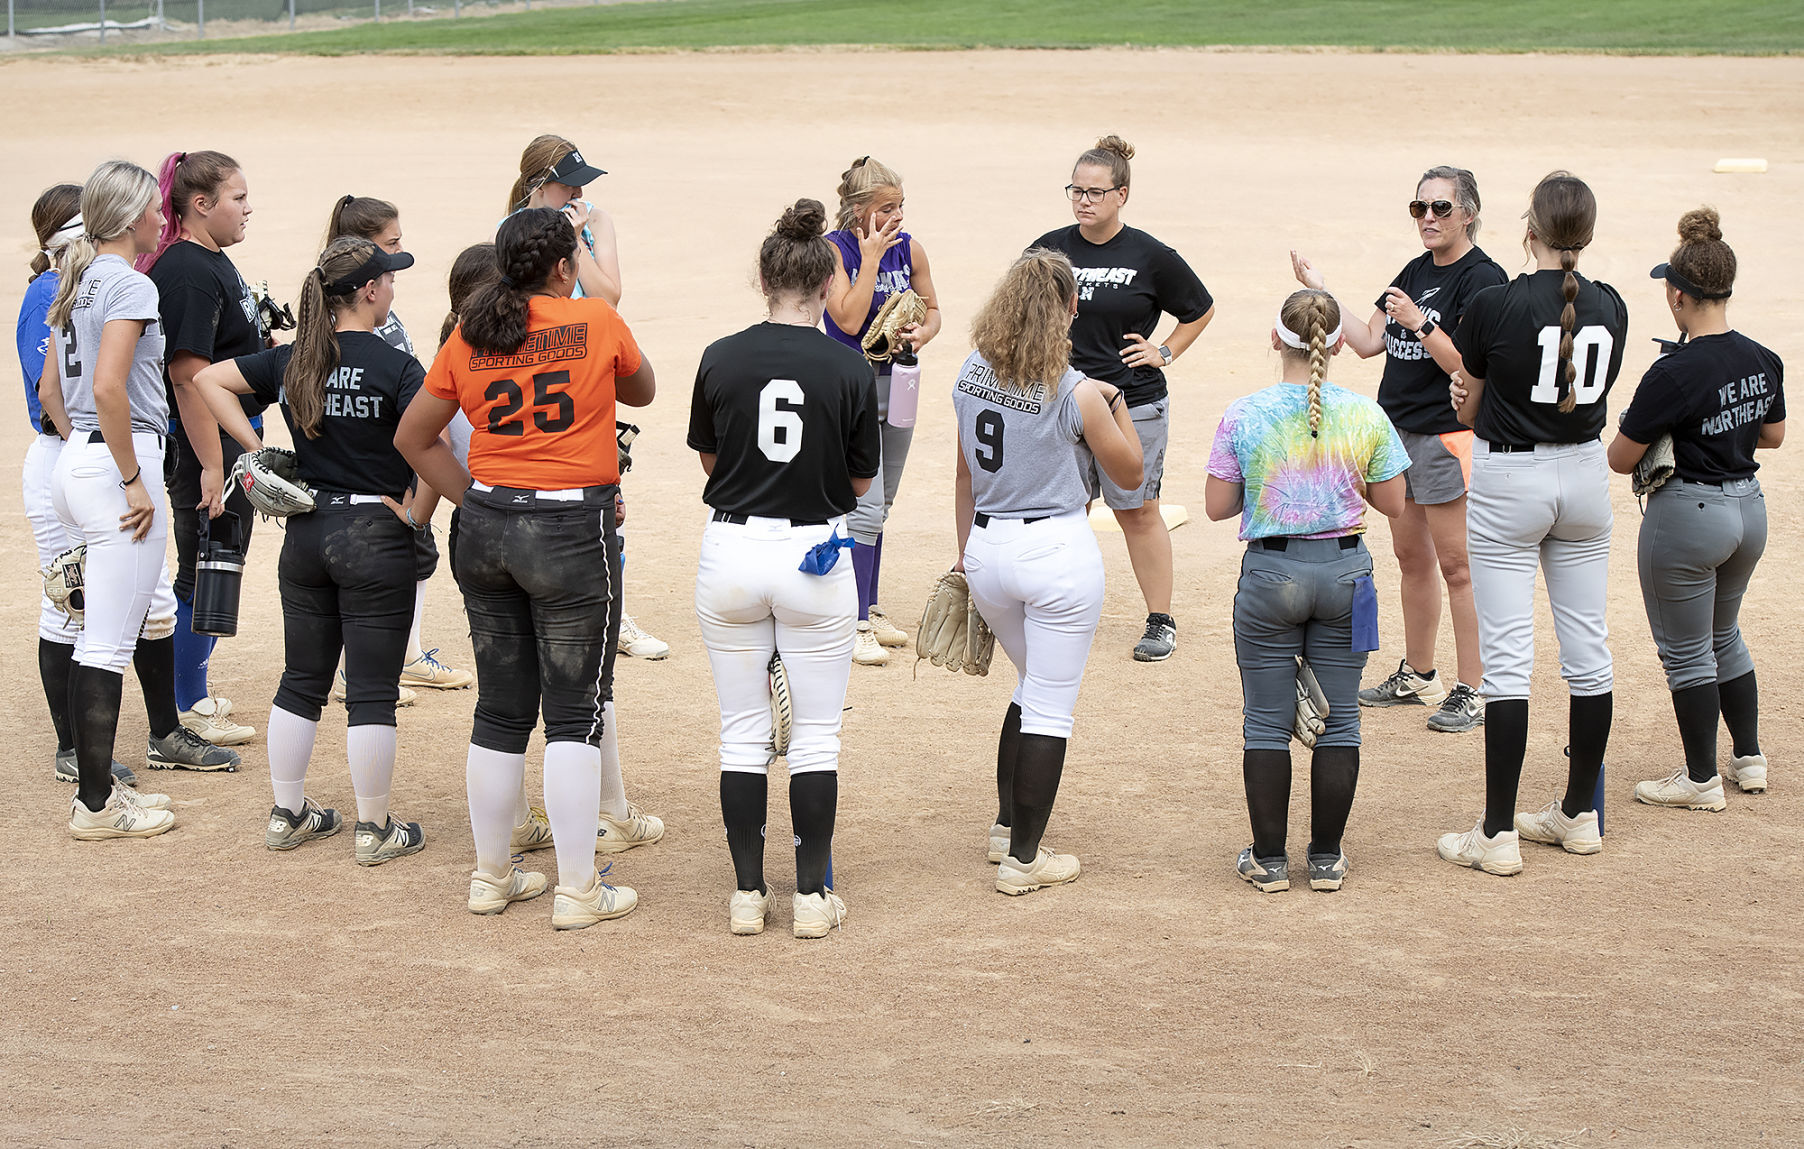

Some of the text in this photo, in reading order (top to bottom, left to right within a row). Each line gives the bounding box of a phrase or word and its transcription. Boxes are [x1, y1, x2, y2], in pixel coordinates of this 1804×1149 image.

[1071, 266, 1138, 286] RTHEAST
[1077, 281, 1119, 289] CKETS
[61, 319, 82, 378] 2
[471, 346, 584, 369] SPORTING GOODS
[1530, 325, 1614, 405] 10
[325, 366, 364, 390] ARE
[1718, 372, 1768, 408] WE ARE
[484, 369, 575, 436] 25
[959, 381, 1040, 414] SPORTING GOODS
[757, 379, 805, 463] 6
[975, 408, 1005, 473] 9
